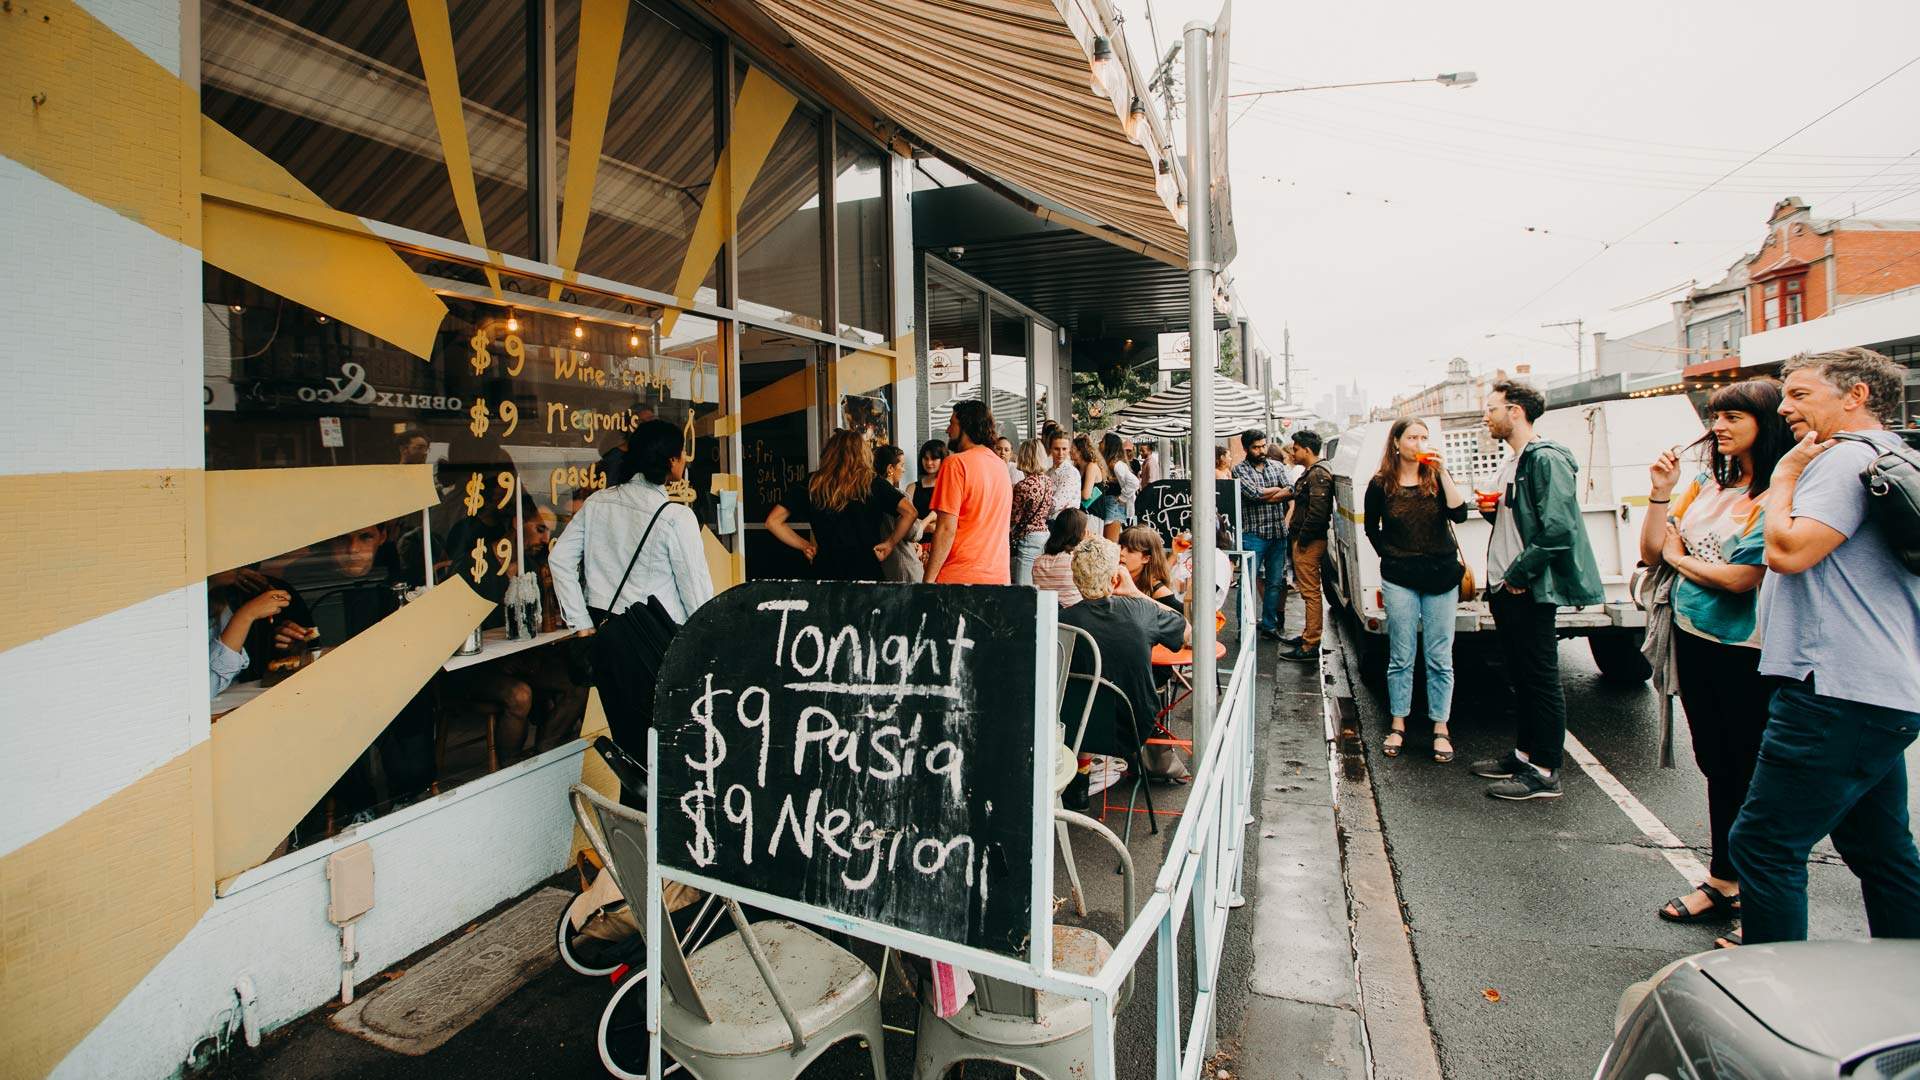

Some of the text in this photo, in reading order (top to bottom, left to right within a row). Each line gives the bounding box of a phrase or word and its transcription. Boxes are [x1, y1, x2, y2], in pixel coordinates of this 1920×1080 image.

[553, 345, 606, 387] Wine
[551, 464, 608, 506] pasta
[757, 599, 975, 716] Tonight
[684, 673, 964, 802] $9 Pasta
[680, 781, 992, 901] $9 Negroni
